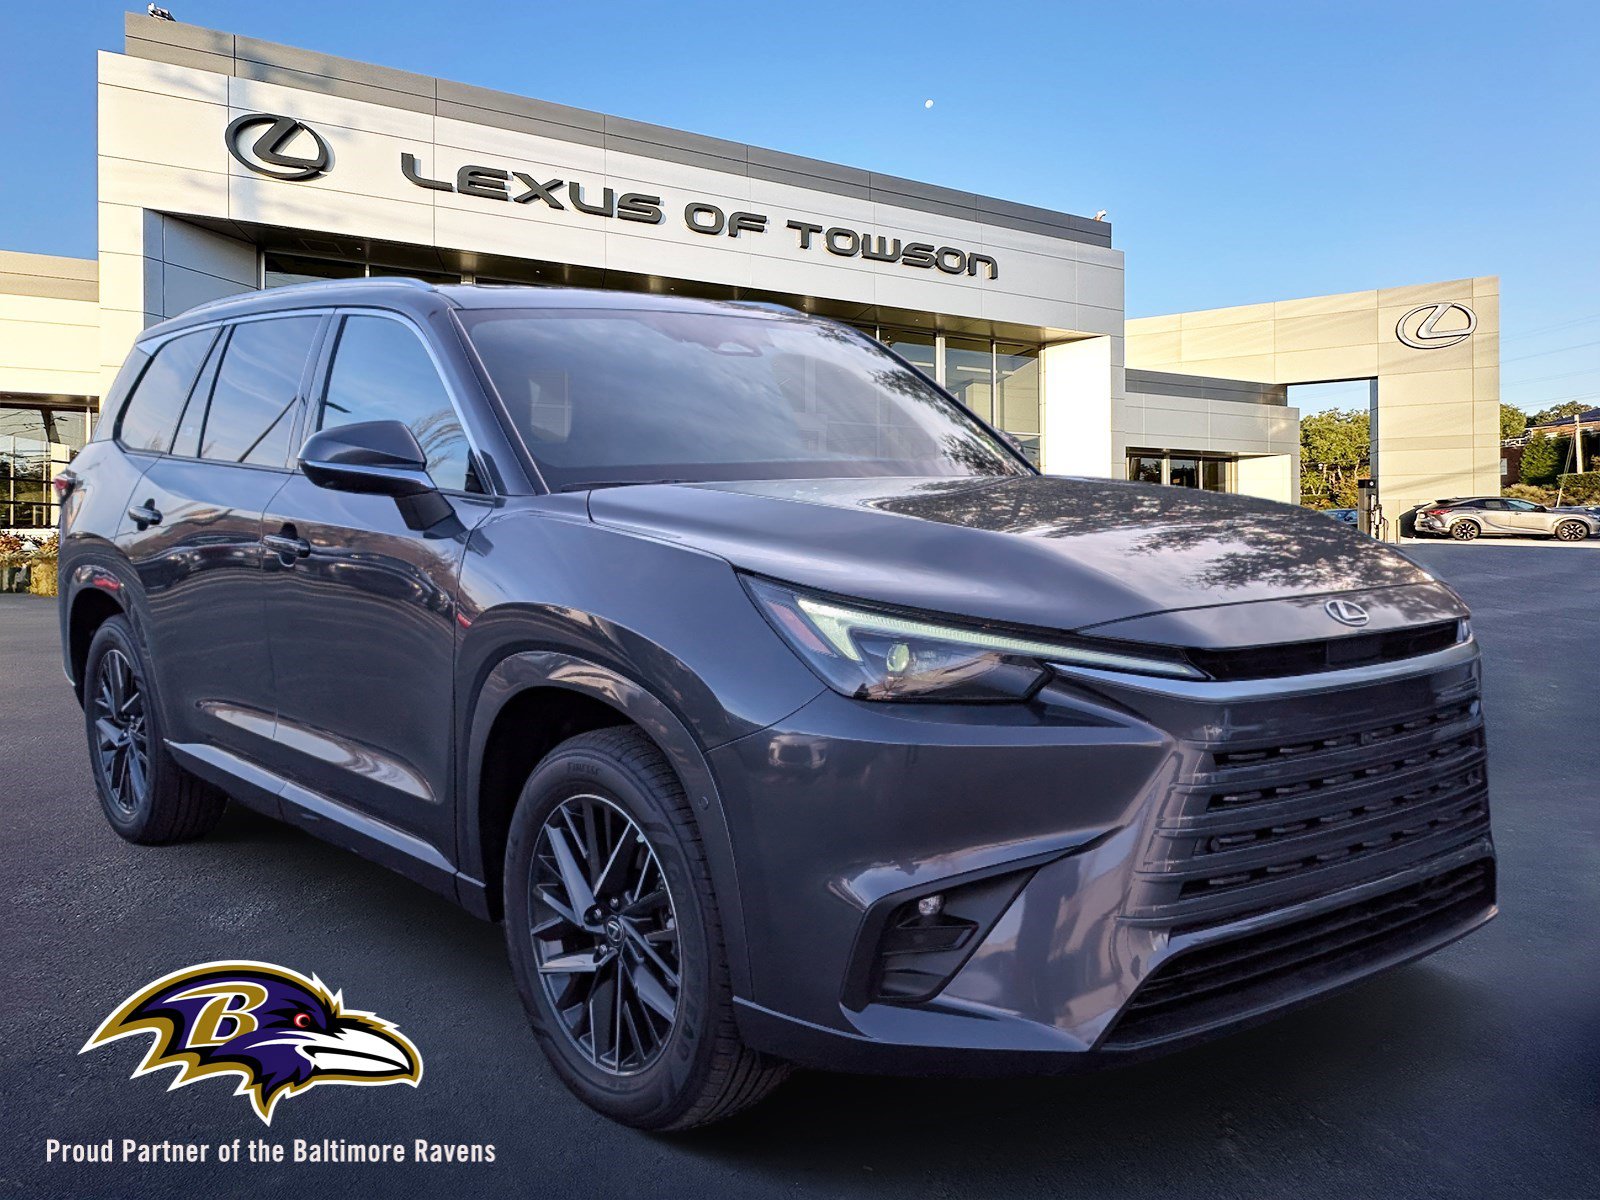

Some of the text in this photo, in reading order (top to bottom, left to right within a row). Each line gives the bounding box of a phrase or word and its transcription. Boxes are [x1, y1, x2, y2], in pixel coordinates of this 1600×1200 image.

[401, 152, 999, 280] LEXUS OF TOWSON
